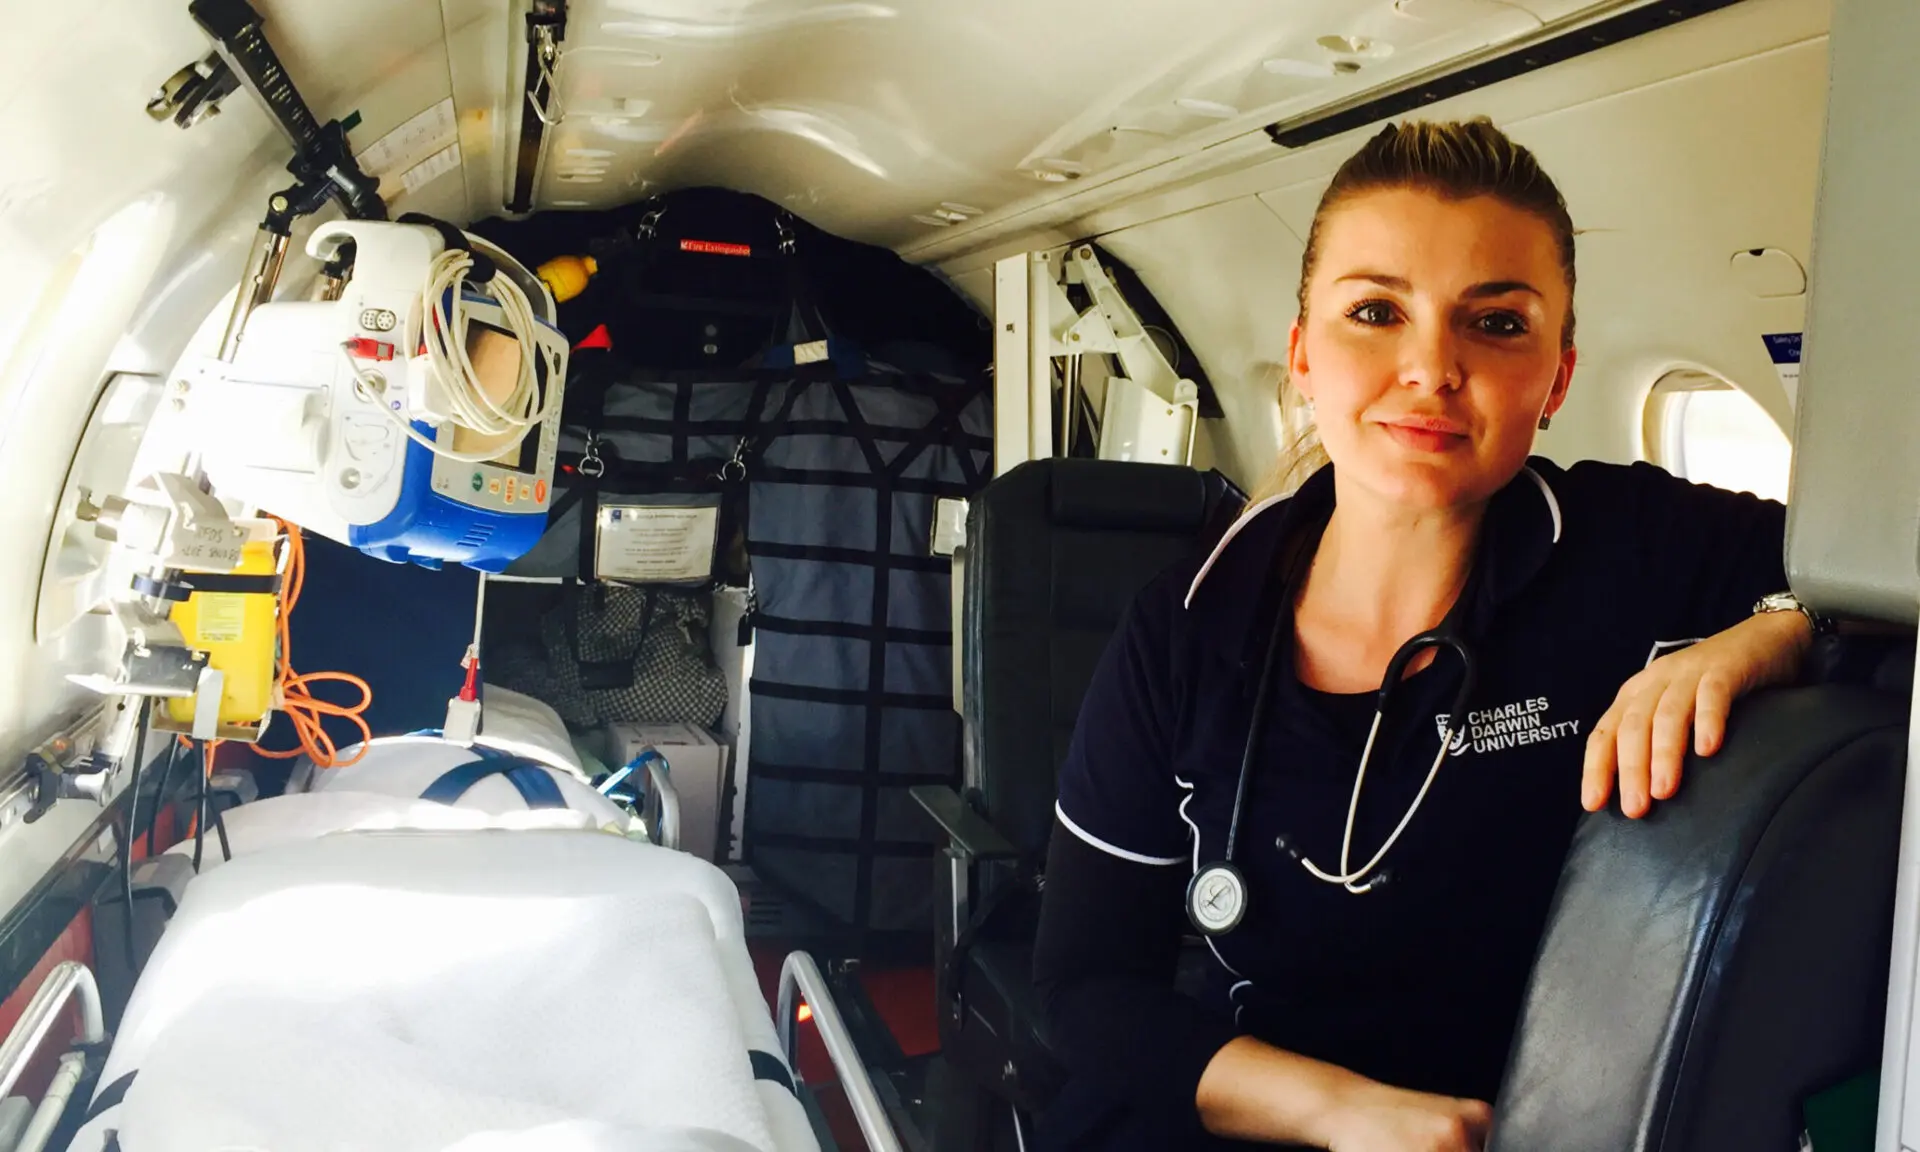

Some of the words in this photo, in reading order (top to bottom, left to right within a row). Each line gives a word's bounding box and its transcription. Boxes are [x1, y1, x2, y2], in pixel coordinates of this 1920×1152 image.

[1468, 697, 1549, 724] CHARLES
[1471, 712, 1541, 739] DARWIN
[1474, 719, 1579, 753] UNIVERSITY
